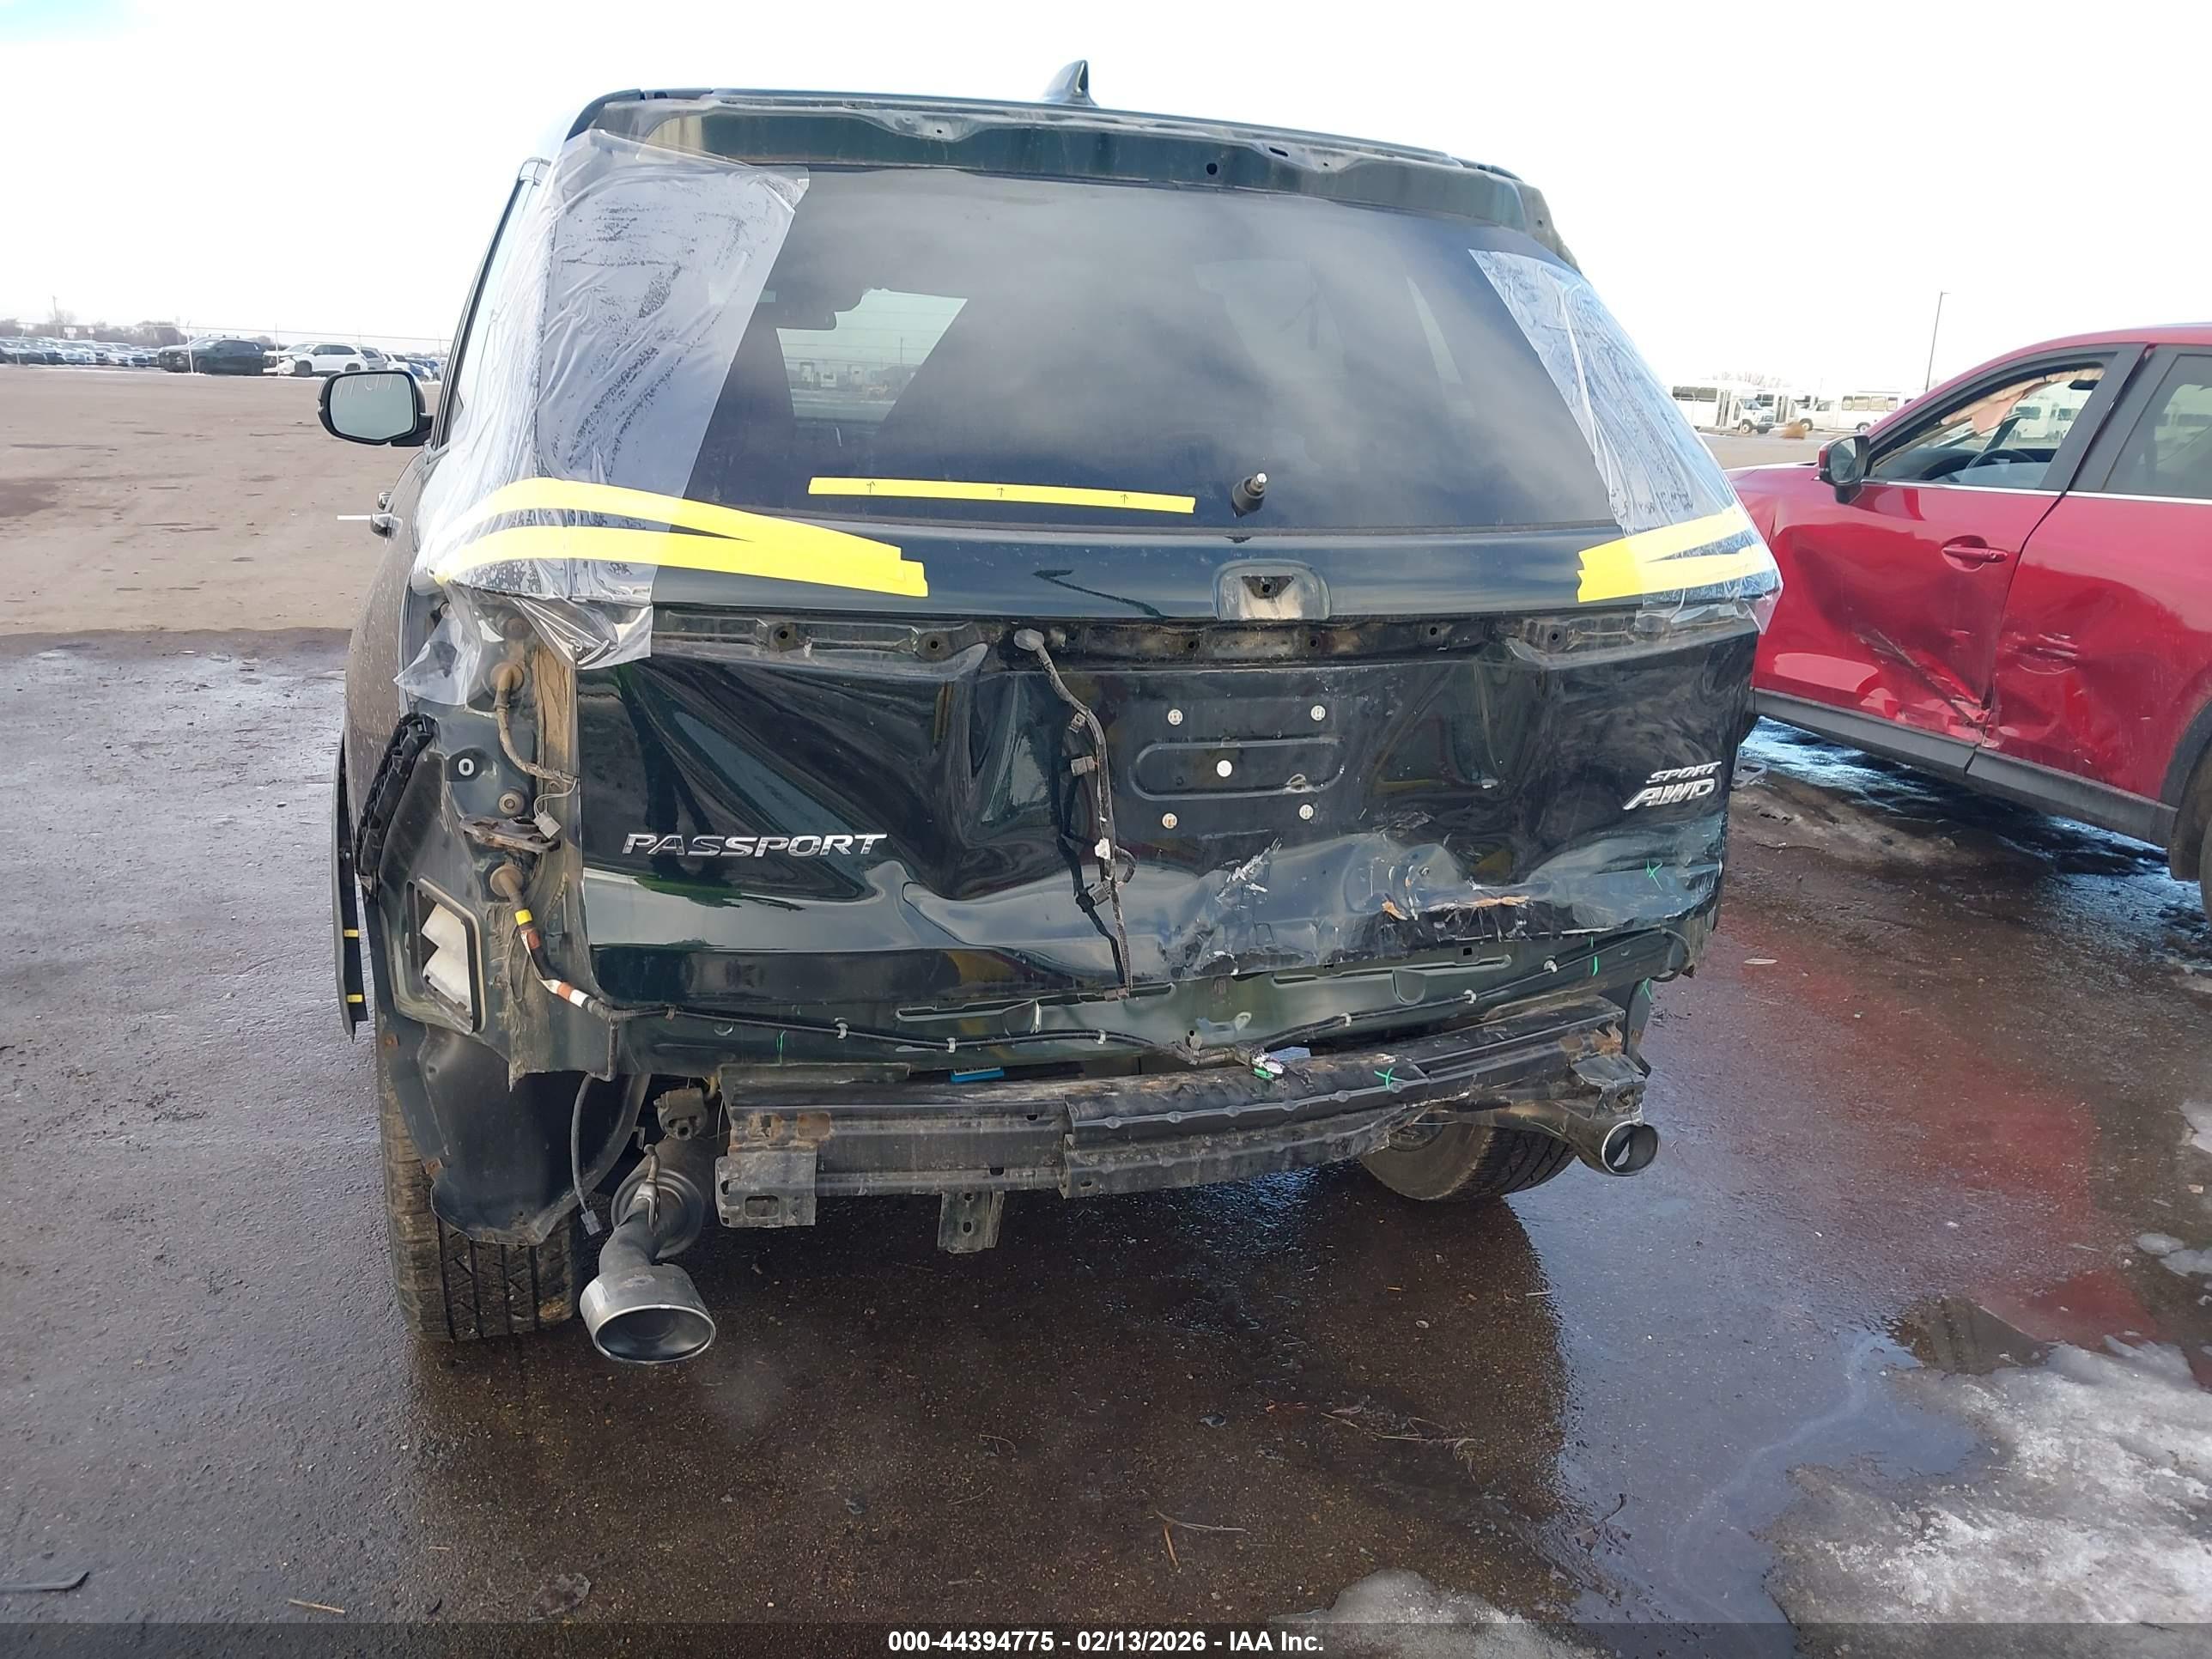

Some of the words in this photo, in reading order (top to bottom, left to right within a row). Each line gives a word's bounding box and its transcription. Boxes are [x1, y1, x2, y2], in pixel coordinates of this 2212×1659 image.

[1645, 761, 1723, 784] SPORT
[1623, 778, 1716, 811] AWD
[622, 832, 889, 857] PASSPORT
